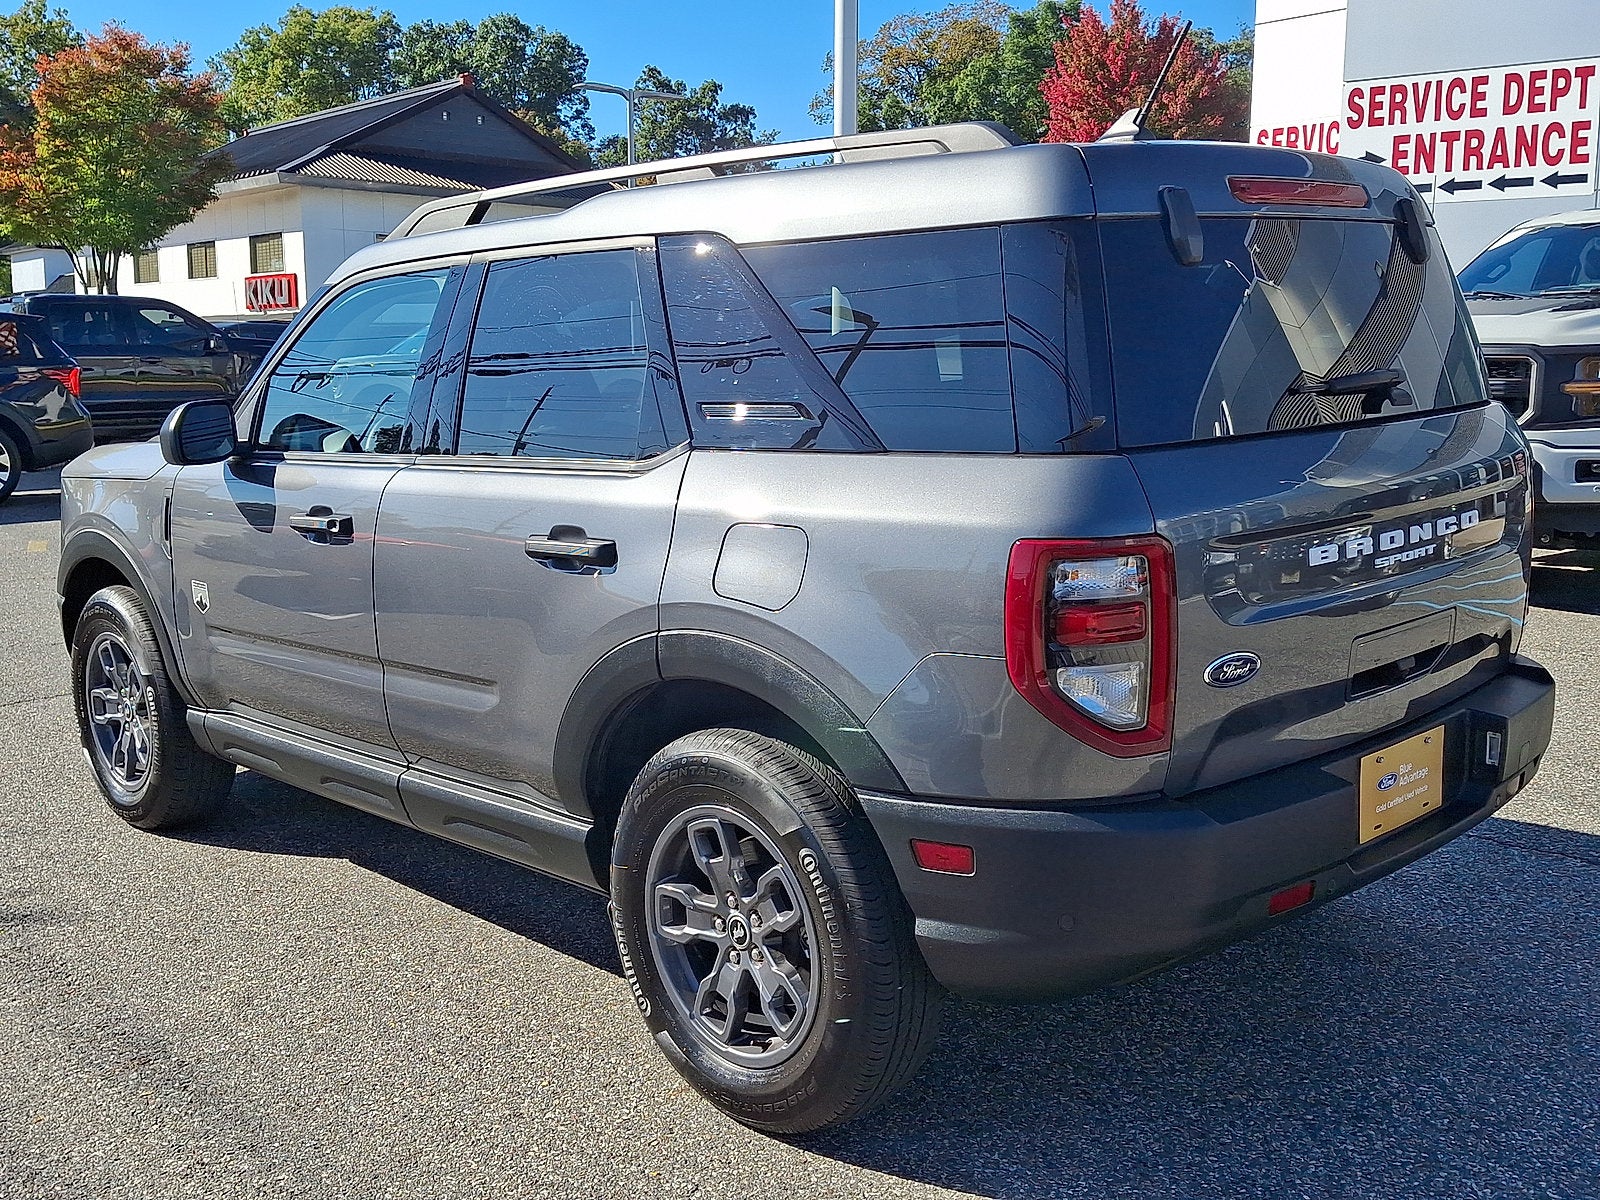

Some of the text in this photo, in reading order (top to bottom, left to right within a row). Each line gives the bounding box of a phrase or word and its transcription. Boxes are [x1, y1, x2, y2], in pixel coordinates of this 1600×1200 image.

[1347, 65, 1596, 130] SERVICE DEPT
[1391, 120, 1592, 176] ENTRANCE
[245, 277, 289, 311] KIKU
[1308, 509, 1480, 568] BRONCO
[1374, 544, 1437, 570] SPORT
[1399, 763, 1412, 775] Blue
[1399, 767, 1429, 787] Advantage
[1375, 802, 1387, 813] Gold
[1404, 790, 1415, 801] Used
